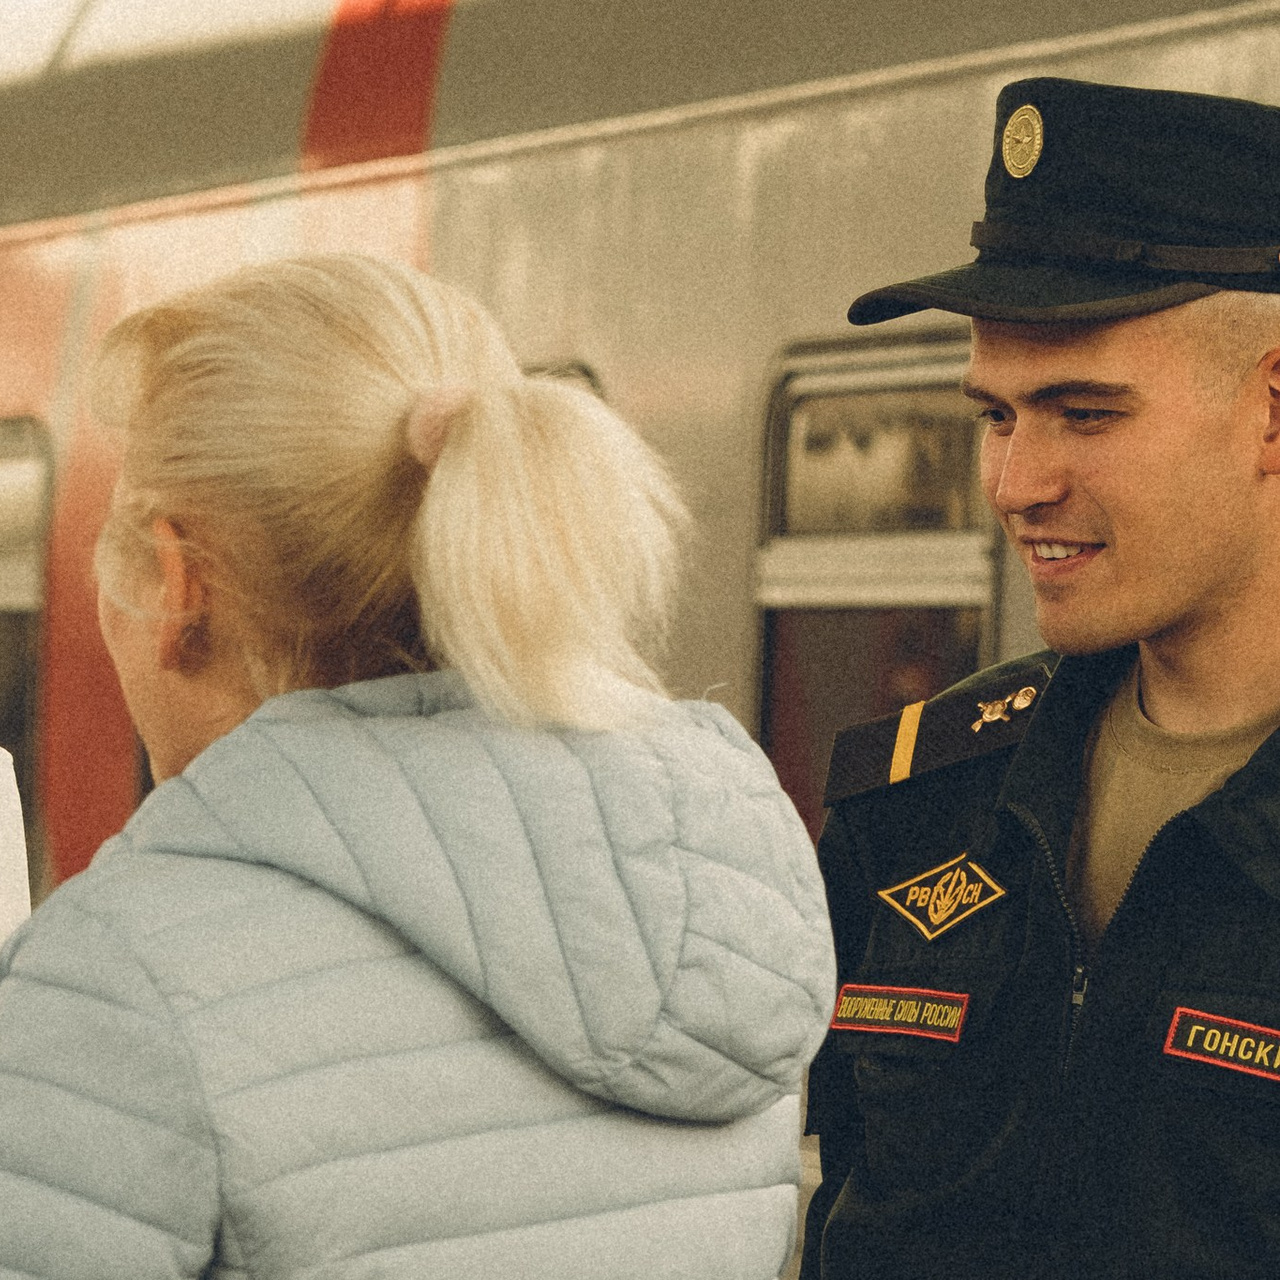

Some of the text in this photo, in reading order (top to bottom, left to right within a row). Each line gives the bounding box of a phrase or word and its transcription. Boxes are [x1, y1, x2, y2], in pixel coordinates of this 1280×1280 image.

[837, 996, 961, 1029] ВООРУЖЕННЫЕ СИЛЫ РОССИИ
